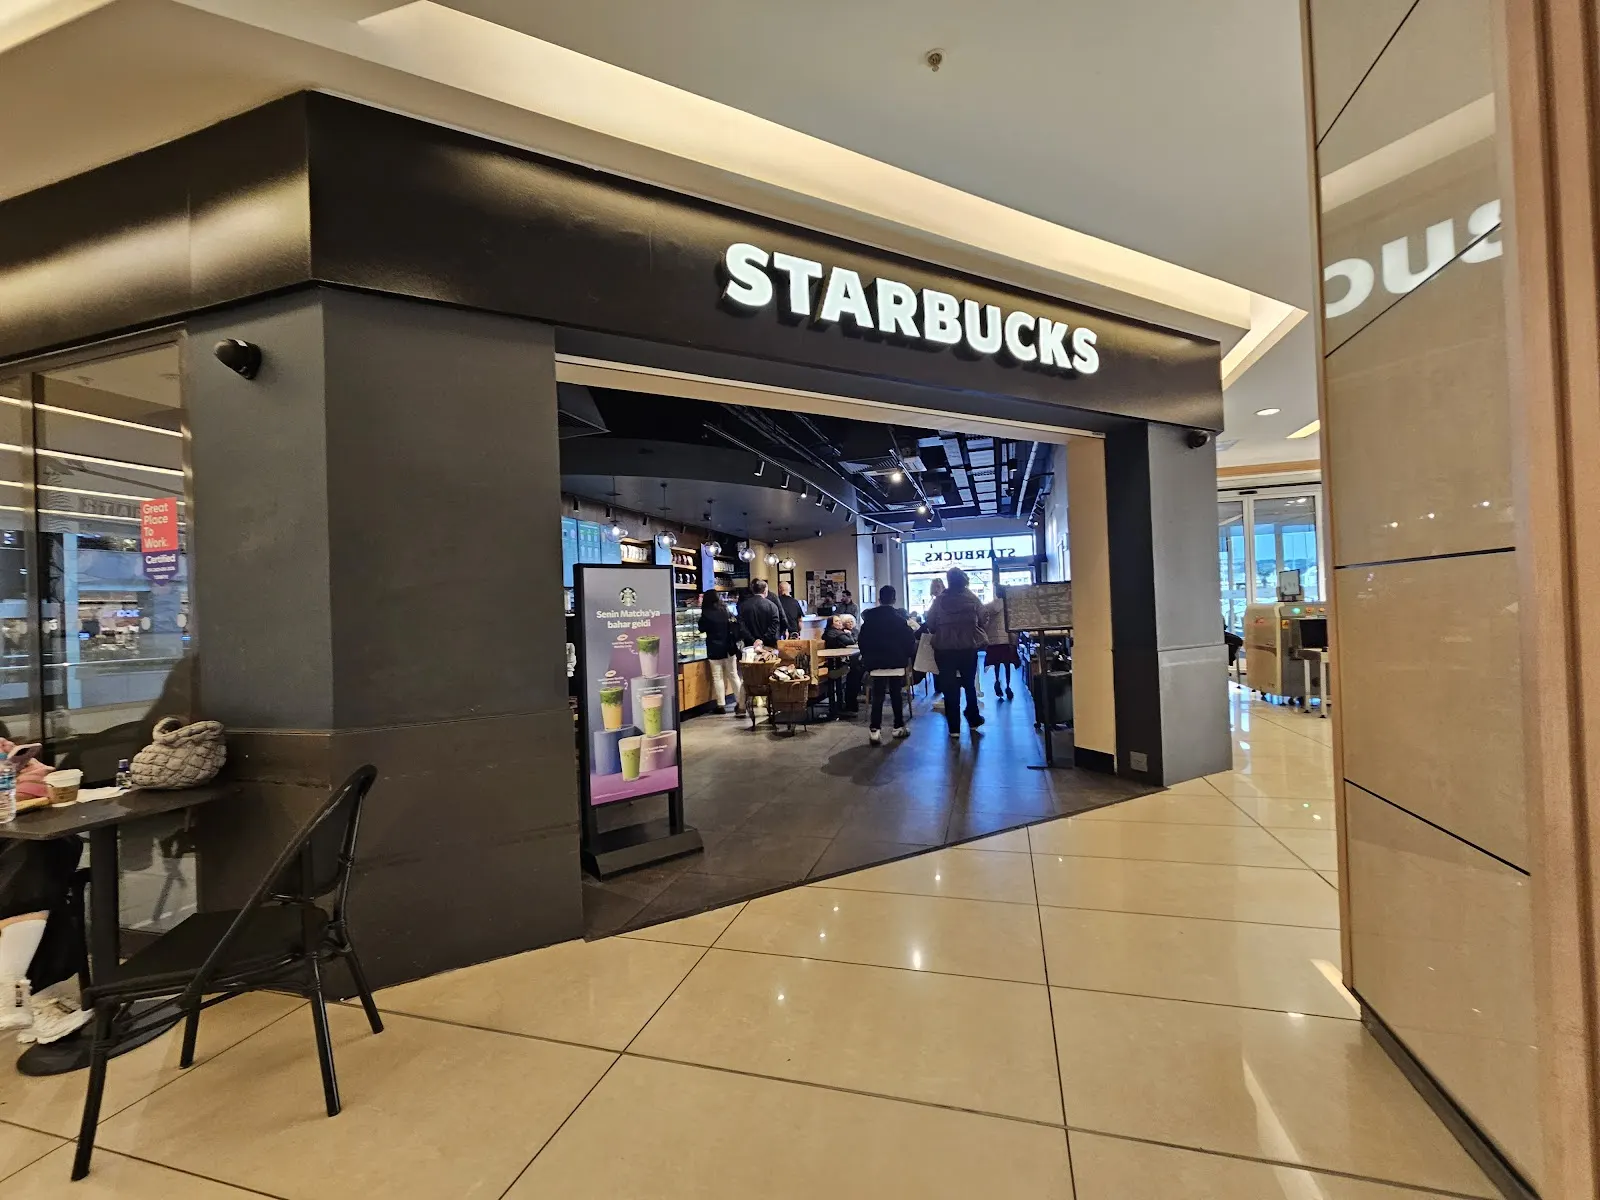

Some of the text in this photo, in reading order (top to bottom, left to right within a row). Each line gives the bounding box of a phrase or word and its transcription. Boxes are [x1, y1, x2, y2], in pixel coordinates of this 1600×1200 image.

[725, 242, 1100, 375] STARBUCKS
[143, 503, 169, 514] Great
[143, 515, 169, 525] Place
[144, 527, 154, 536] To
[145, 554, 176, 564] Certified
[596, 609, 661, 619] Senin Matcha'ya
[607, 619, 652, 630] bahar geldi
